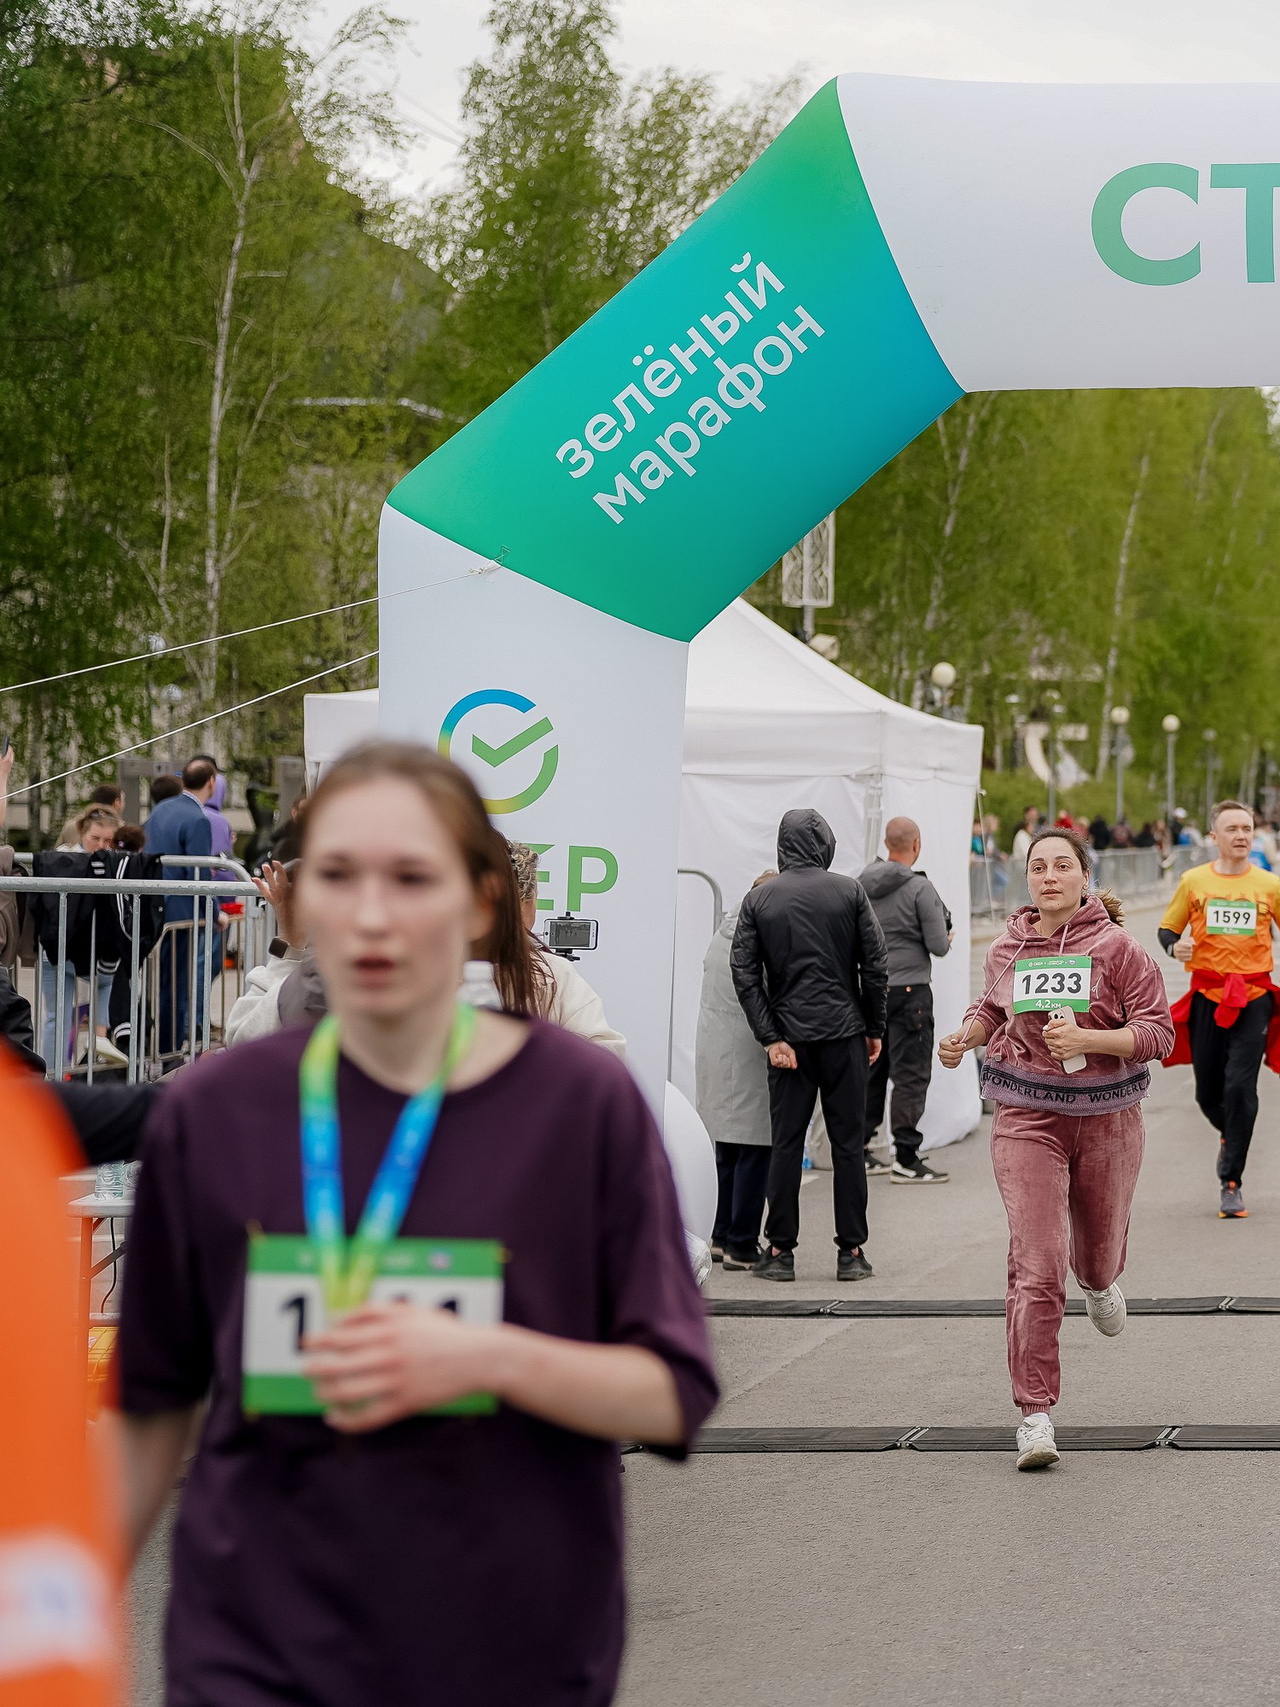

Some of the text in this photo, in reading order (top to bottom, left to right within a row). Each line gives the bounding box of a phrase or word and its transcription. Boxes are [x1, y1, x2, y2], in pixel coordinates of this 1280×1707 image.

[555, 251, 786, 479] зелёный
[592, 304, 826, 525] марафон
[522, 842, 619, 913] ЕР
[1213, 910, 1251, 925] 1599
[1021, 972, 1082, 995] 1233
[1035, 999, 1051, 1009] 4,2
